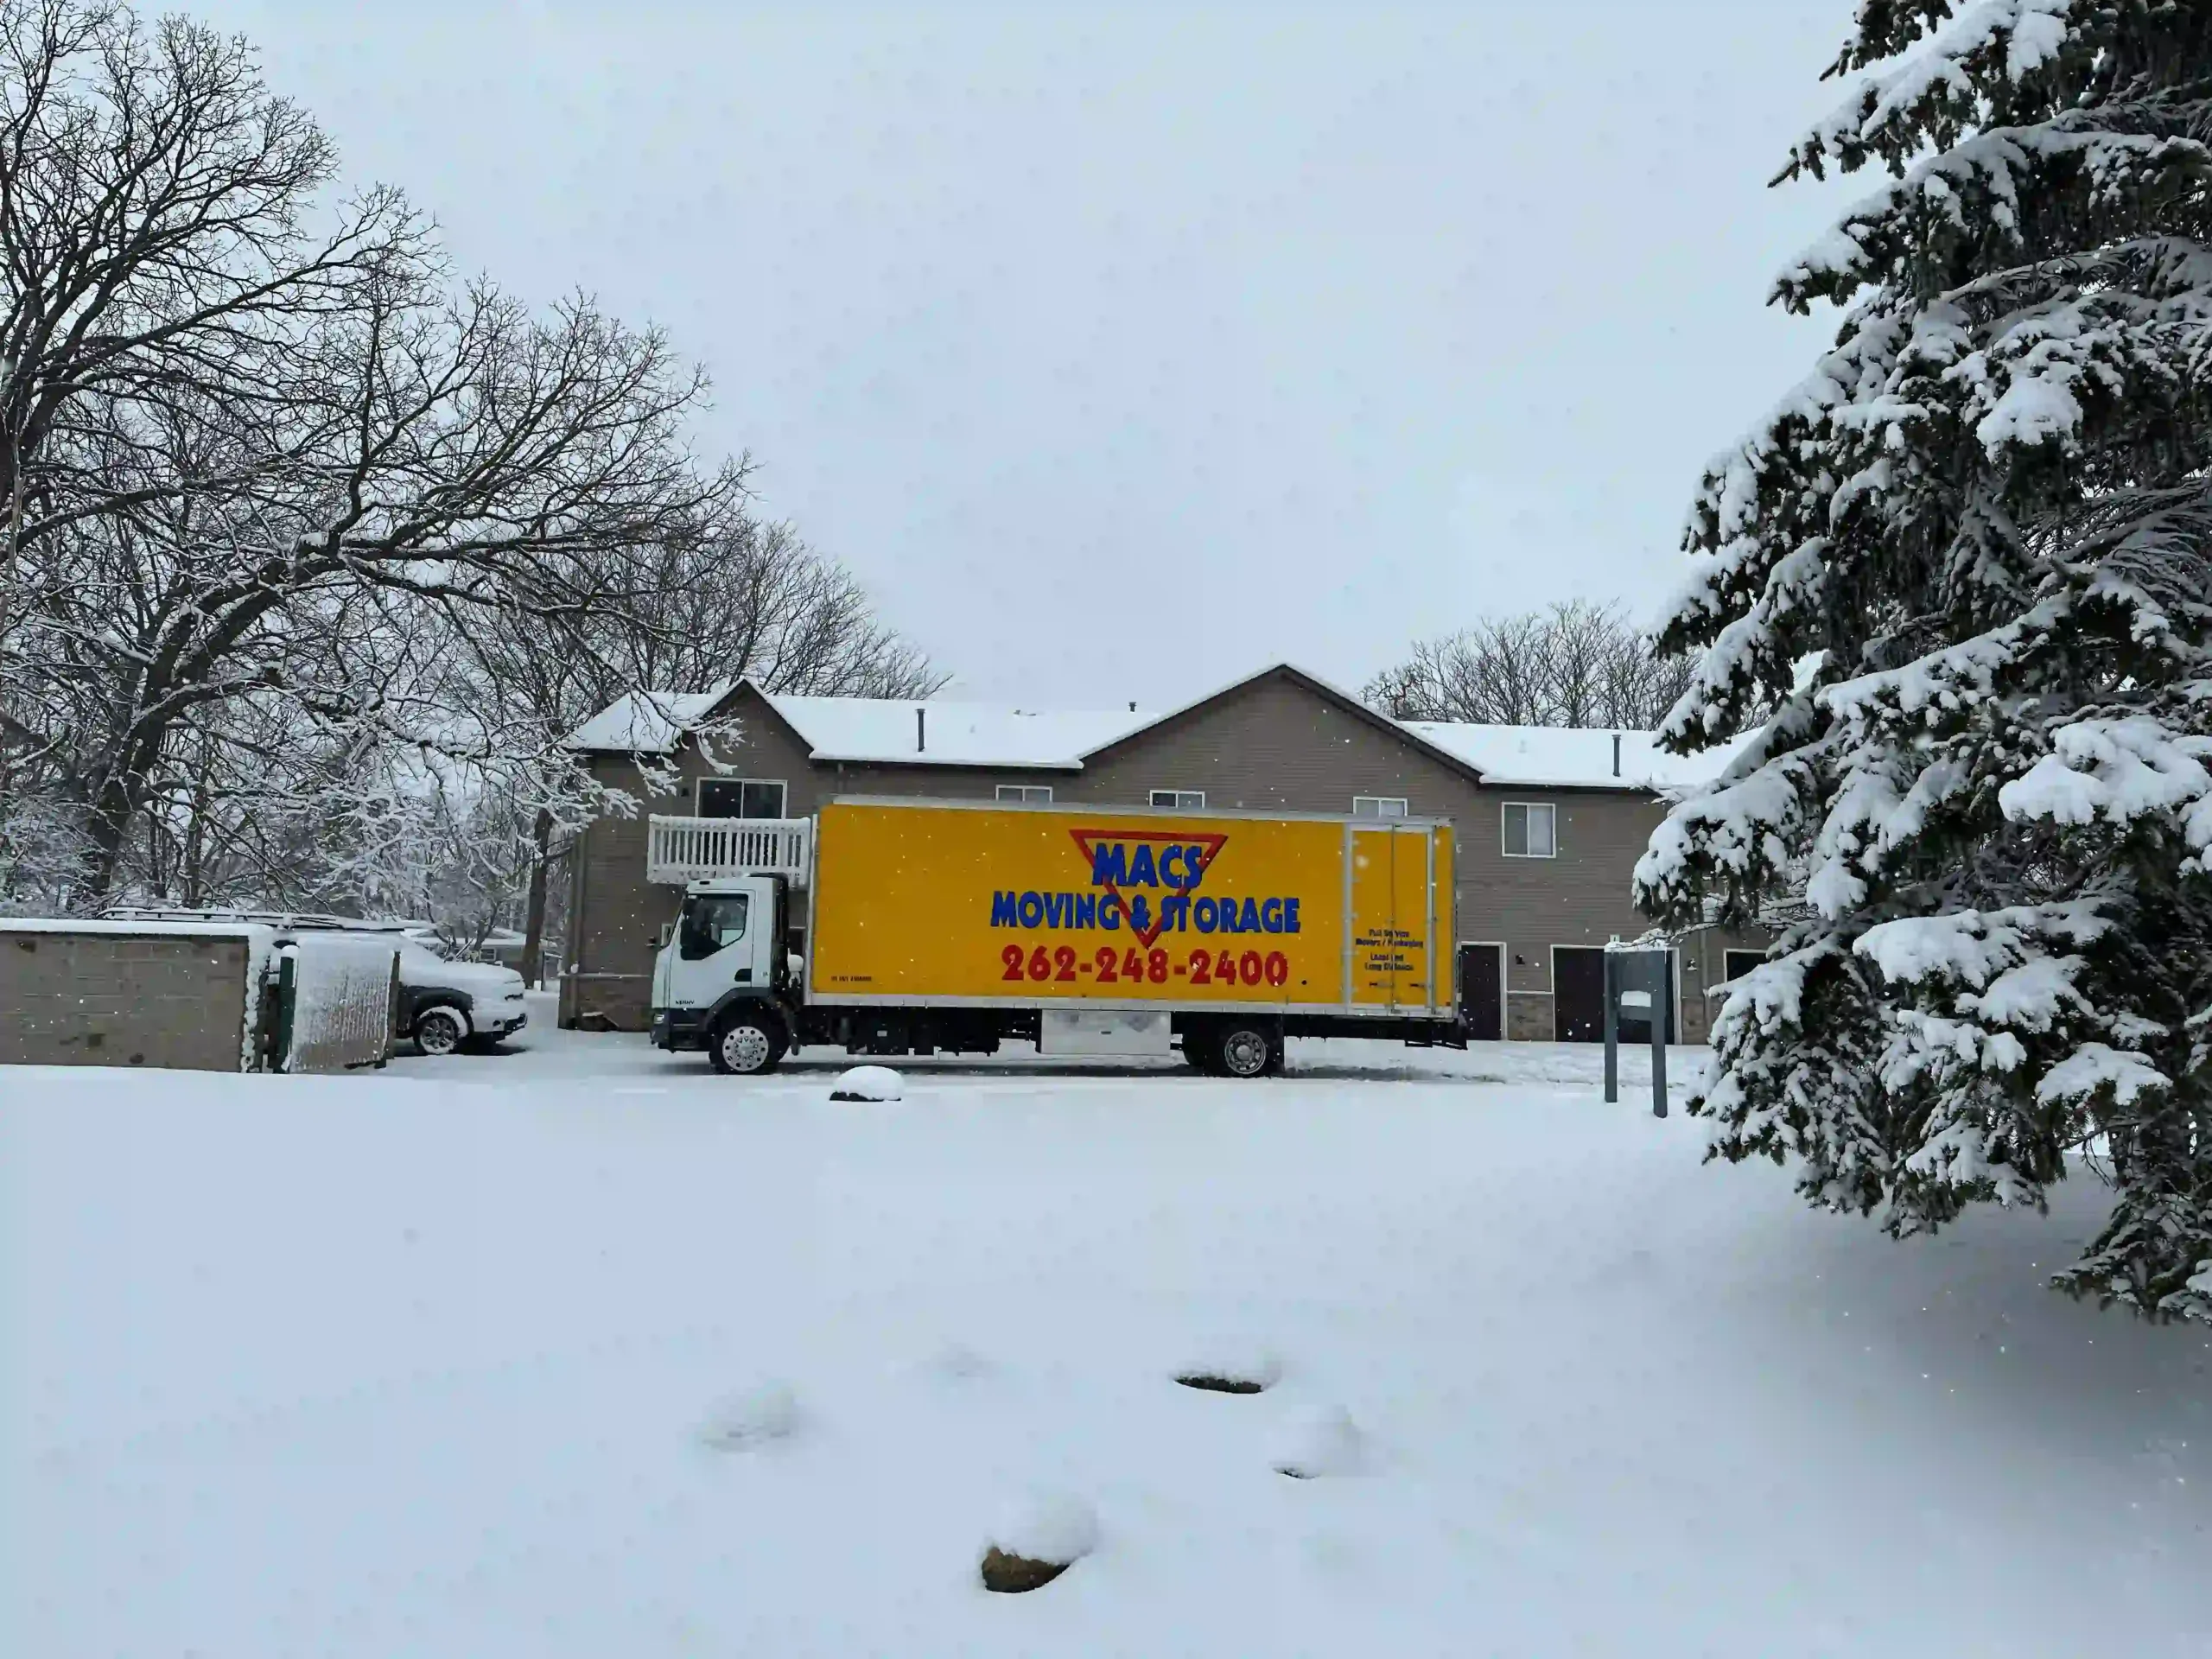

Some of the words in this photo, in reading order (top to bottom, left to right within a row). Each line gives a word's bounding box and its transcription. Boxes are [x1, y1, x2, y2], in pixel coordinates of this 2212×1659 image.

[1091, 843, 1202, 888] MACS
[990, 891, 1120, 931] MOVING
[1130, 894, 1151, 931] &
[1160, 895, 1300, 933] STORAGE
[1001, 944, 1288, 986] 262-248-2400
